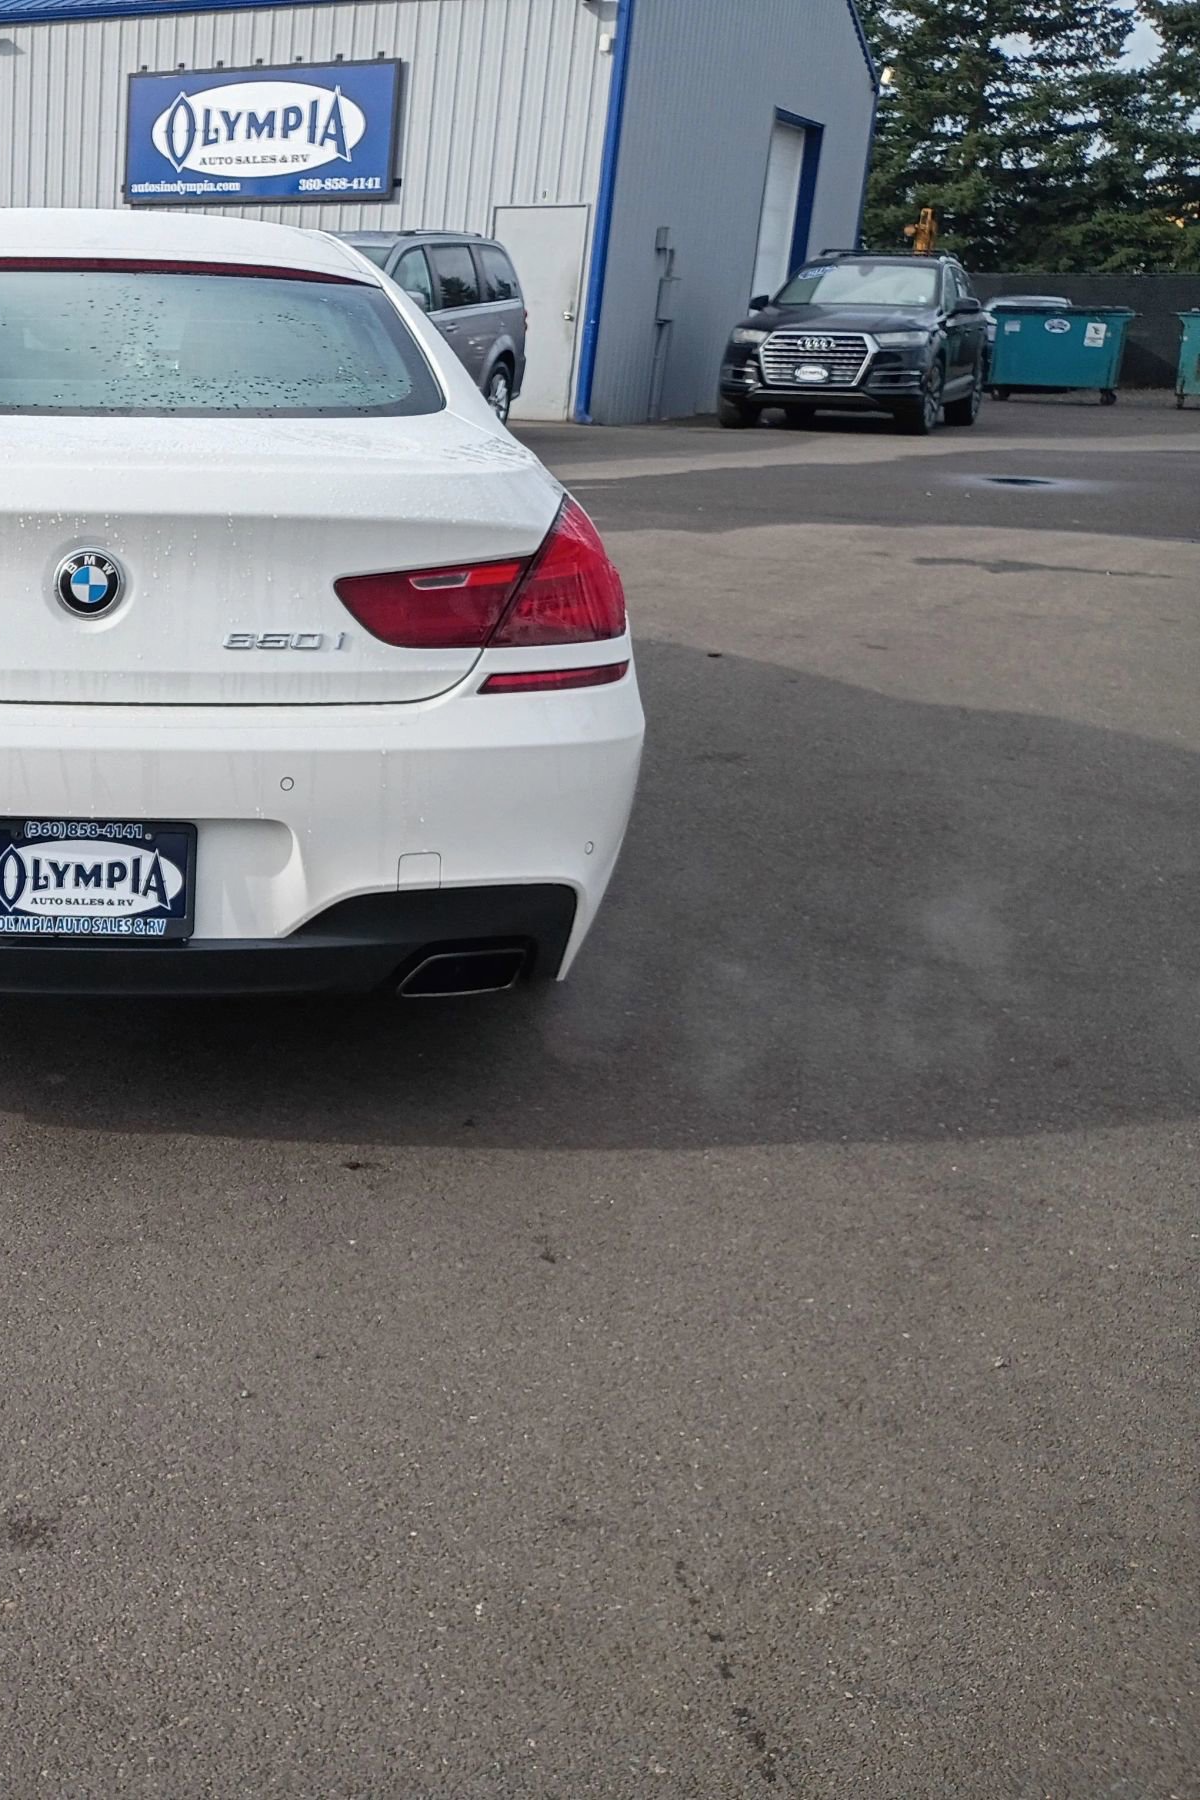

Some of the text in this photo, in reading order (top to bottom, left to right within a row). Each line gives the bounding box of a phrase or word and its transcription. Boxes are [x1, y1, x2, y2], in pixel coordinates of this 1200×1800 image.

[166, 85, 351, 172] OLYMPIA
[199, 154, 310, 166] AUTO SALES & RV
[131, 180, 241, 195] autosinolympia.com
[299, 177, 381, 191] 360-858-4141
[65, 556, 115, 575] BMW
[24, 821, 143, 839] (360) 858-4141
[30, 897, 135, 907] AUTO SALES & RV
[55, 917, 92, 933] AUTO
[92, 918, 131, 934] SALES
[133, 919, 145, 934] &
[146, 919, 167, 935] RV
